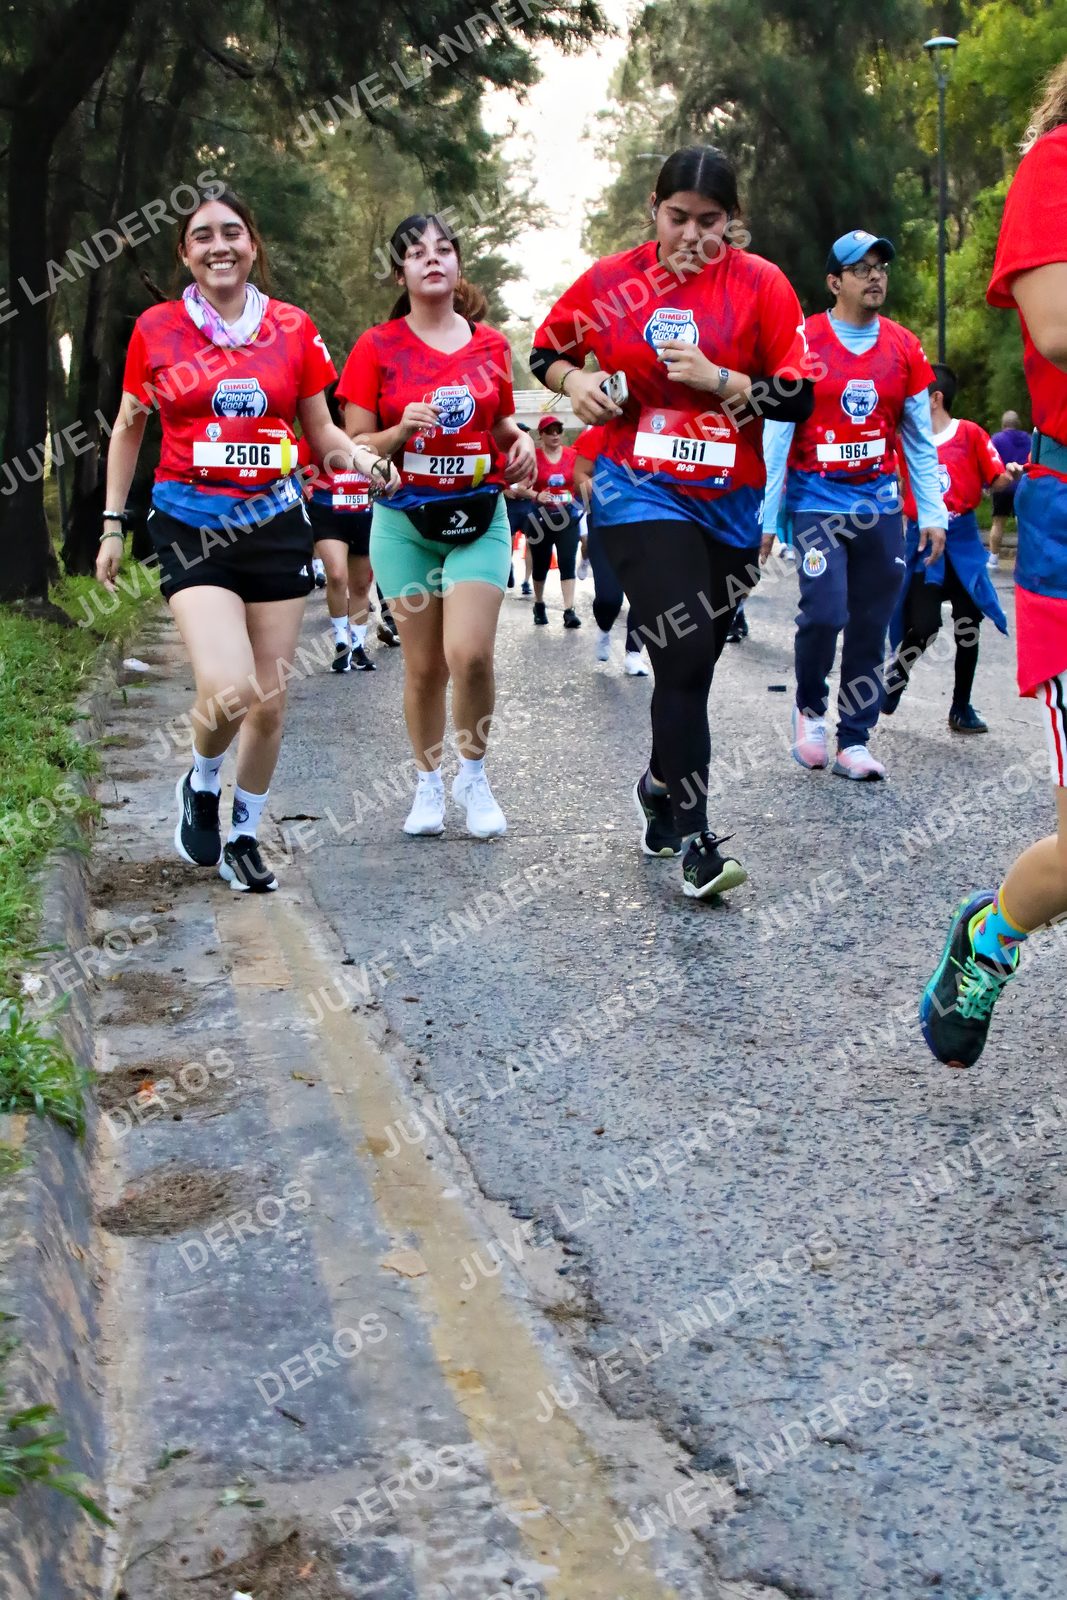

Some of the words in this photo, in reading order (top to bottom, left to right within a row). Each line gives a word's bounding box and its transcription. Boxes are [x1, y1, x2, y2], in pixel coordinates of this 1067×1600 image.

[659, 313, 688, 321] BIMBO
[658, 322, 686, 334] Global
[652, 330, 675, 341] Race
[223, 383, 255, 391] BIMBO
[225, 392, 255, 402] Global
[221, 401, 244, 410] Race
[671, 438, 706, 462] 1511
[840, 443, 868, 459] 1964
[225, 445, 270, 466] 2506
[430, 457, 464, 475] 2122
[714, 477, 725, 485] 5K
[344, 495, 364, 504] 17551
[441, 526, 477, 536] CONVERSE
